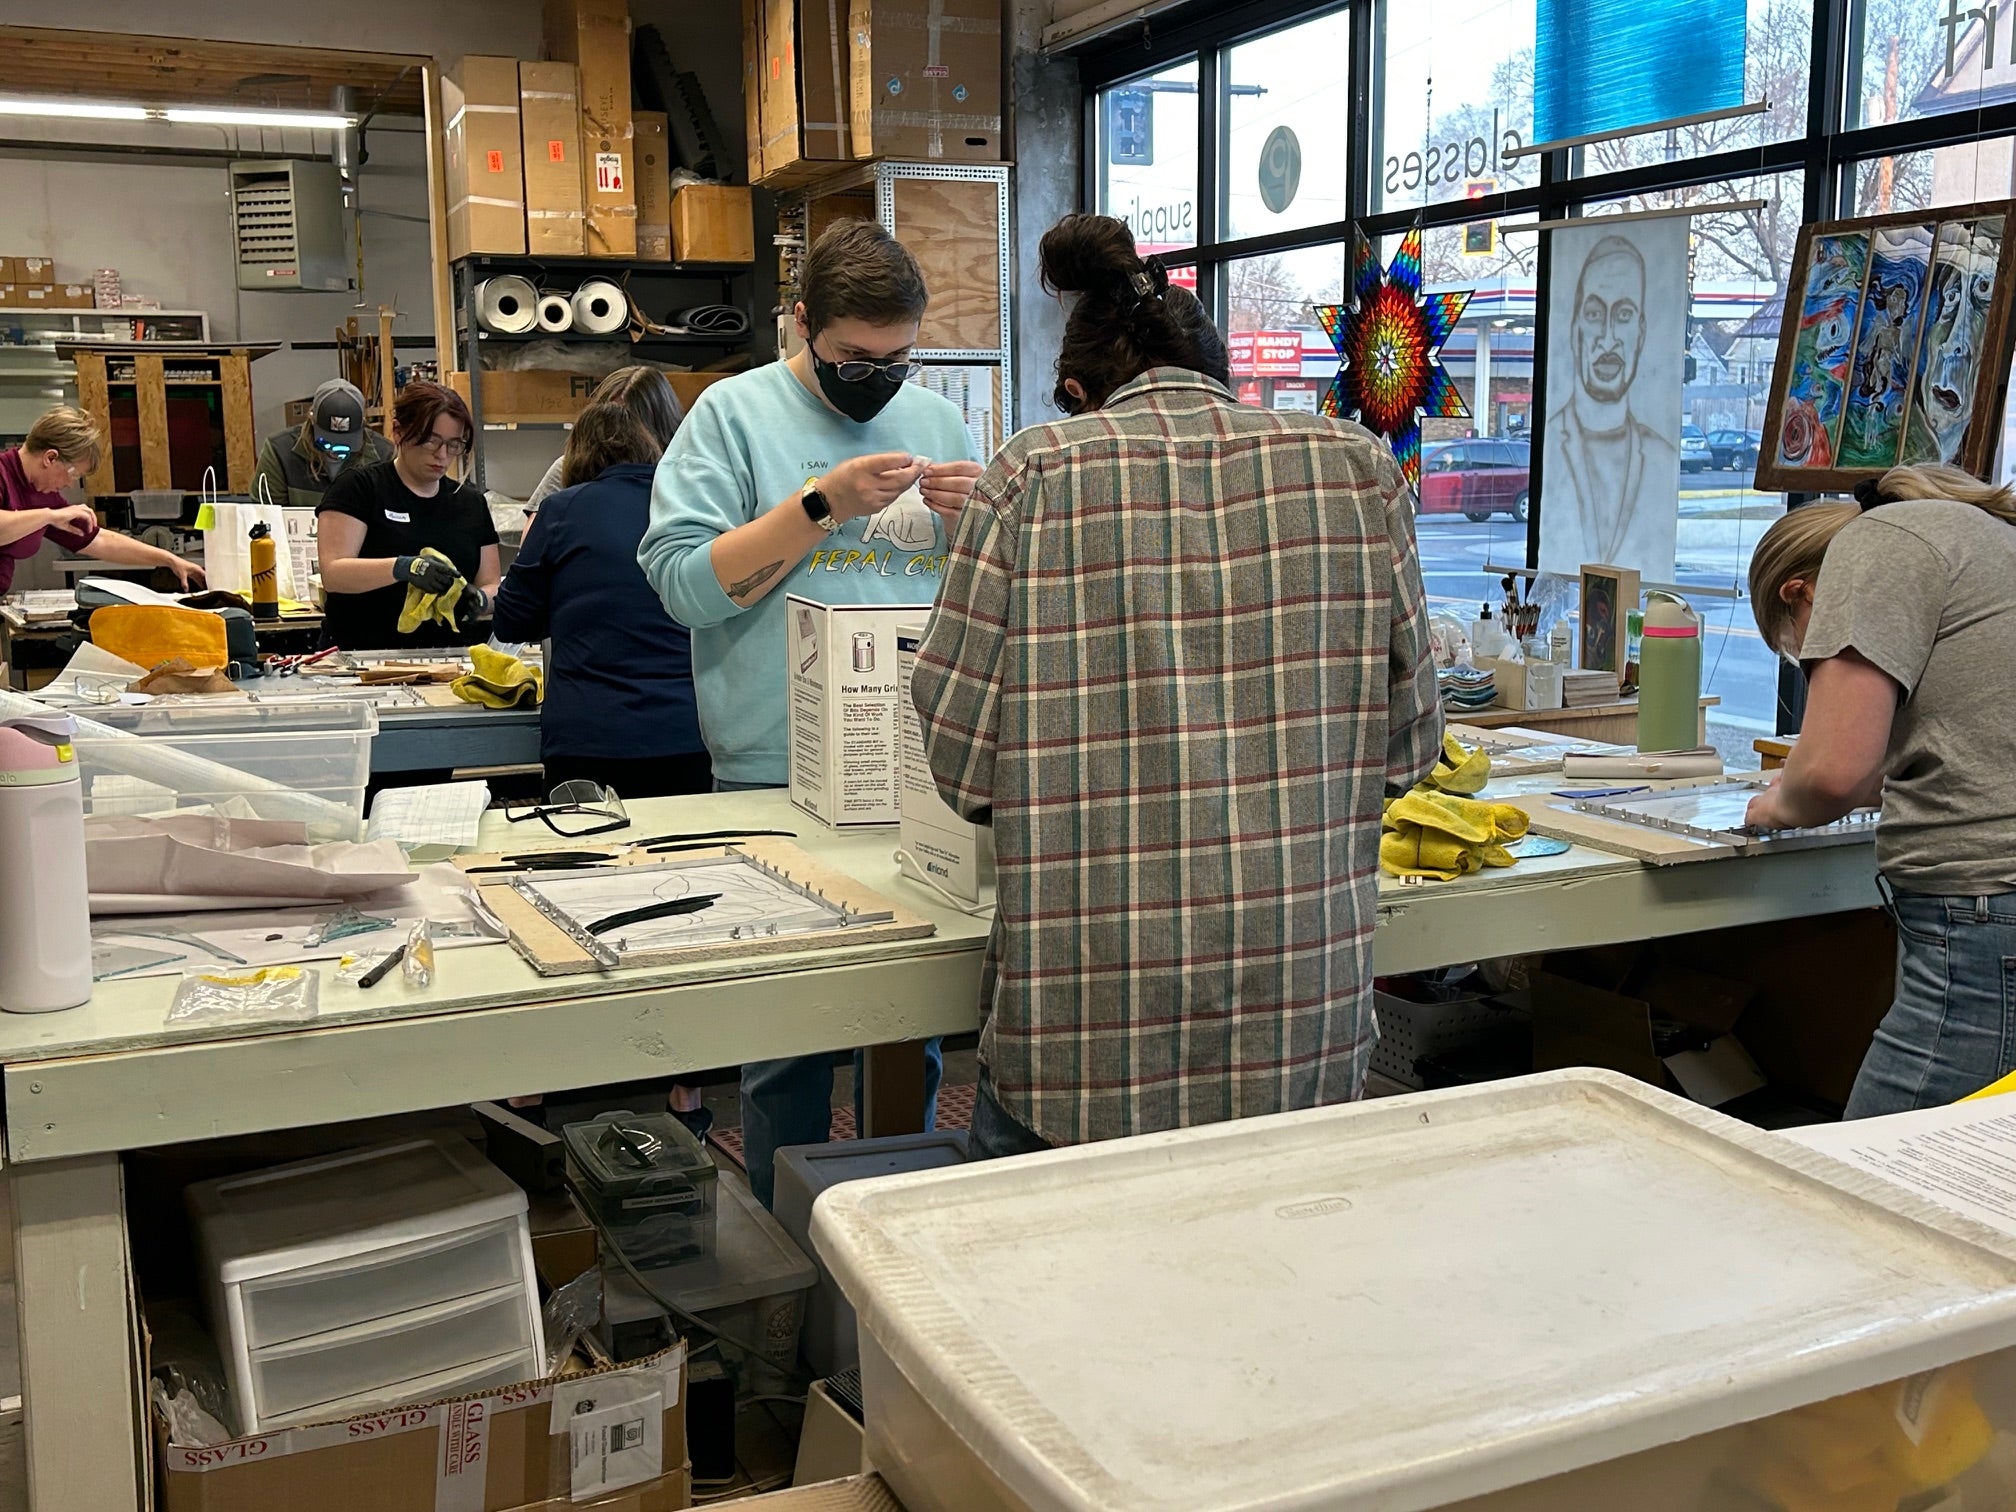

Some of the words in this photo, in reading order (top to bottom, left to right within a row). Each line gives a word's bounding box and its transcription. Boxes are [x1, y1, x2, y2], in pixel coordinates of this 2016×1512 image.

[1257, 336, 1300, 347] HANDY
[1262, 348, 1296, 359] STOP
[807, 461, 829, 470] SAW
[807, 549, 897, 578] FERAL
[841, 685, 859, 693] How
[861, 685, 880, 694] Many
[502, 1388, 542, 1406] ASS
[349, 1410, 427, 1437] GLASS
[452, 1404, 463, 1430] ANDLE
[464, 1402, 484, 1464] GLASS
[184, 1440, 268, 1466] GLASS
